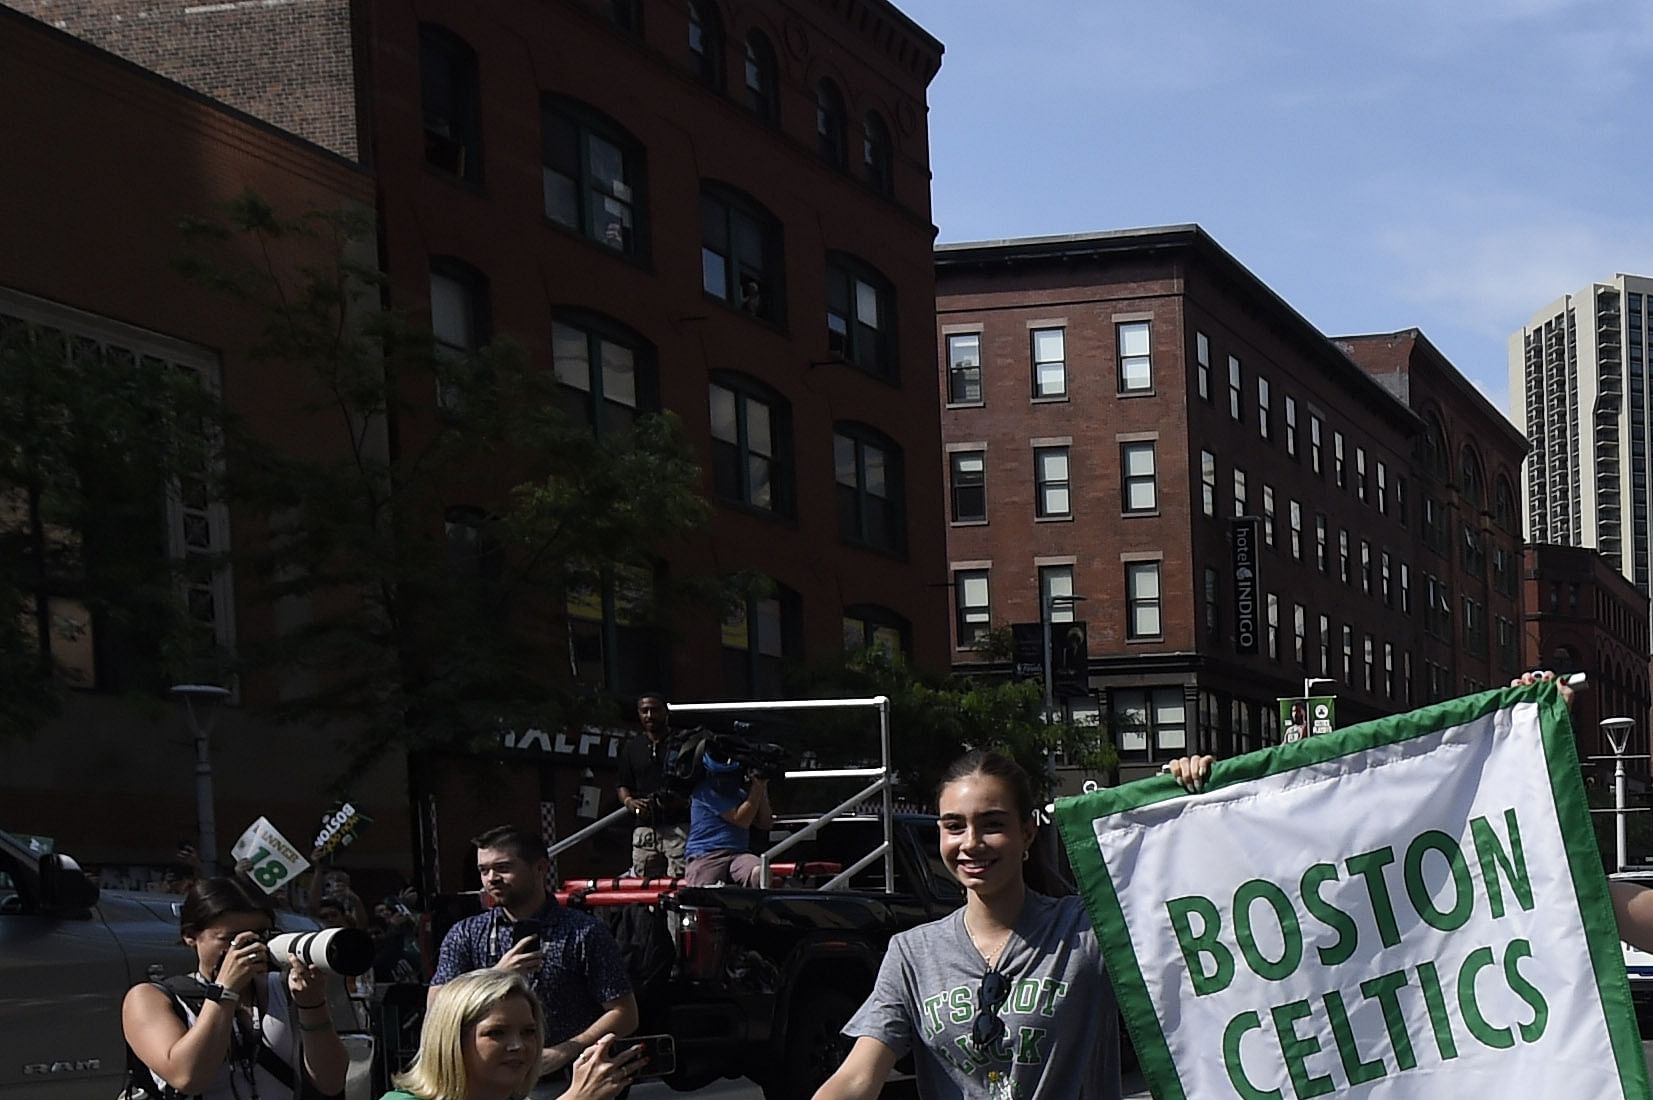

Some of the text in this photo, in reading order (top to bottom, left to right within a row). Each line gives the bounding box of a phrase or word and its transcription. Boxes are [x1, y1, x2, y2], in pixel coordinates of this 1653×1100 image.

[1236, 527, 1254, 648] hotel INDIGO
[313, 803, 356, 848] BOSTON
[251, 846, 288, 888] 18
[1165, 806, 1536, 998] BOSTON
[924, 985, 976, 1041] T'S
[23, 1058, 101, 1075] RAM
